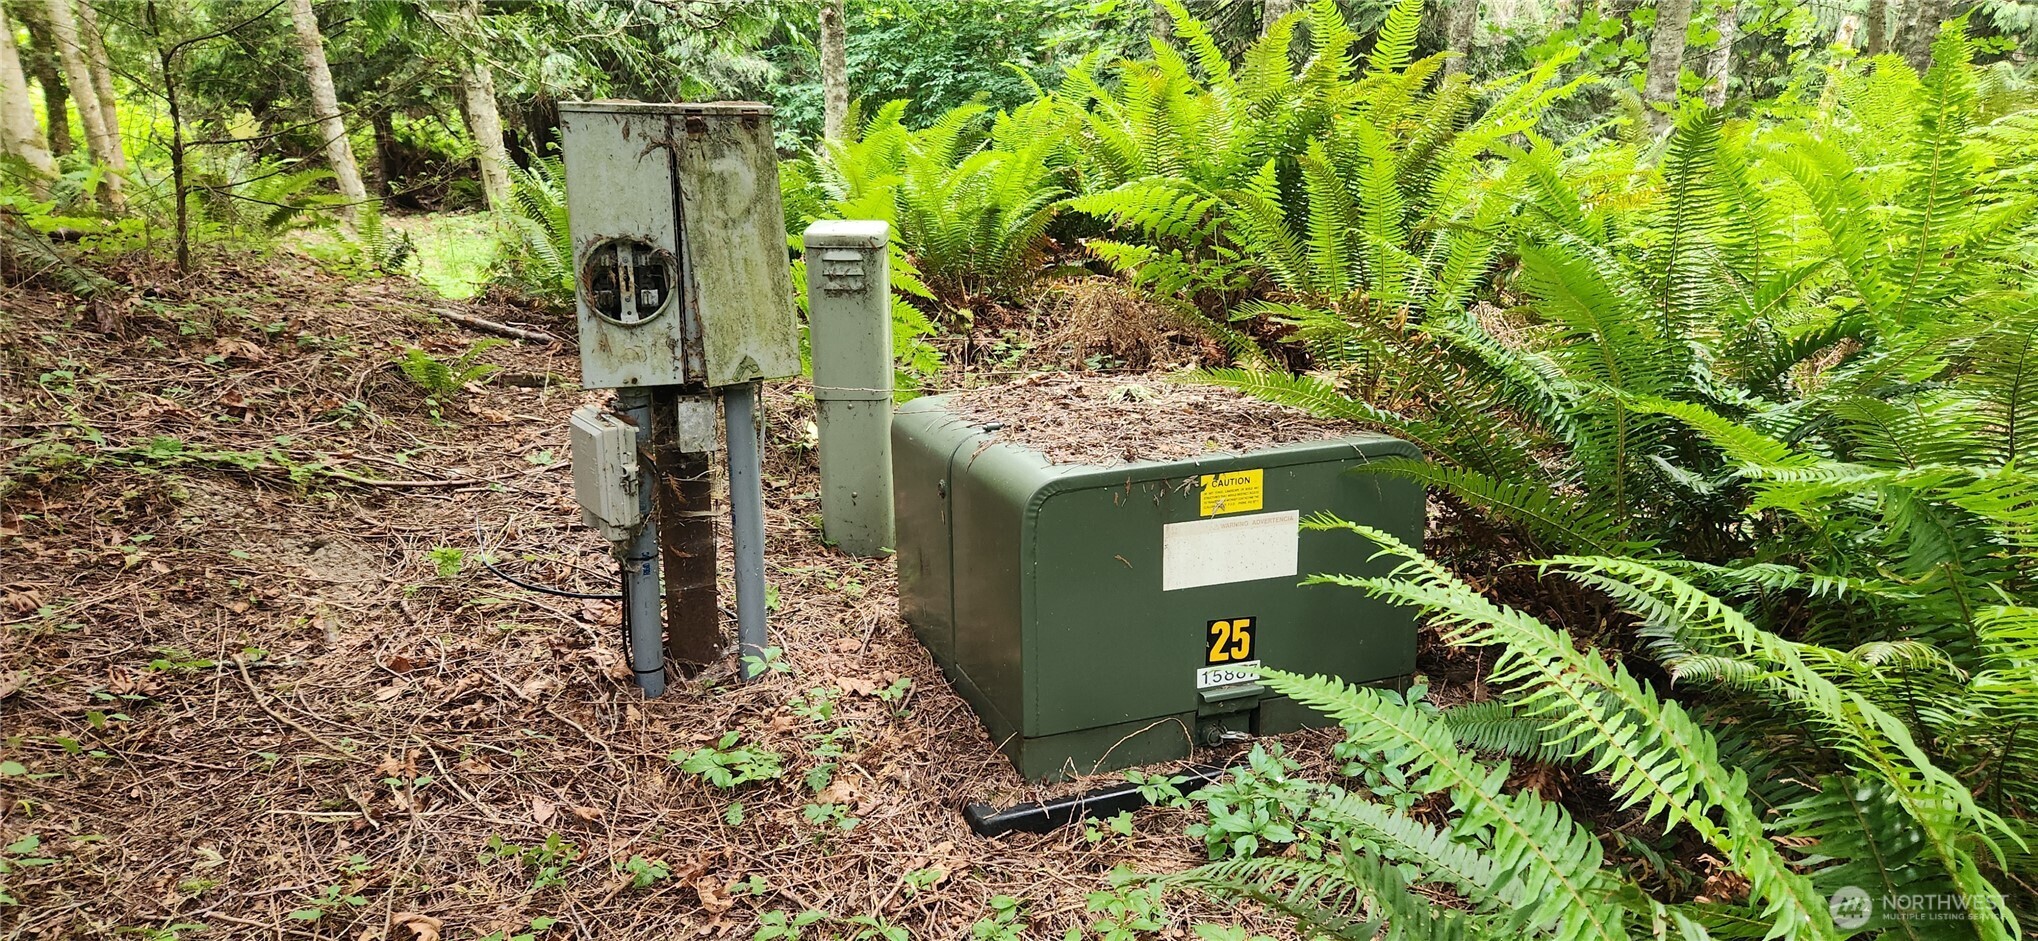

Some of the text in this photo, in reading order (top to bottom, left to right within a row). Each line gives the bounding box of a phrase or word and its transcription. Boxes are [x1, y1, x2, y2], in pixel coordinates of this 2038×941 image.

[1211, 477, 1251, 488] CAUTION
[1220, 515, 1294, 529] WARNING ADVERTENCIA
[1209, 618, 1251, 662] 25
